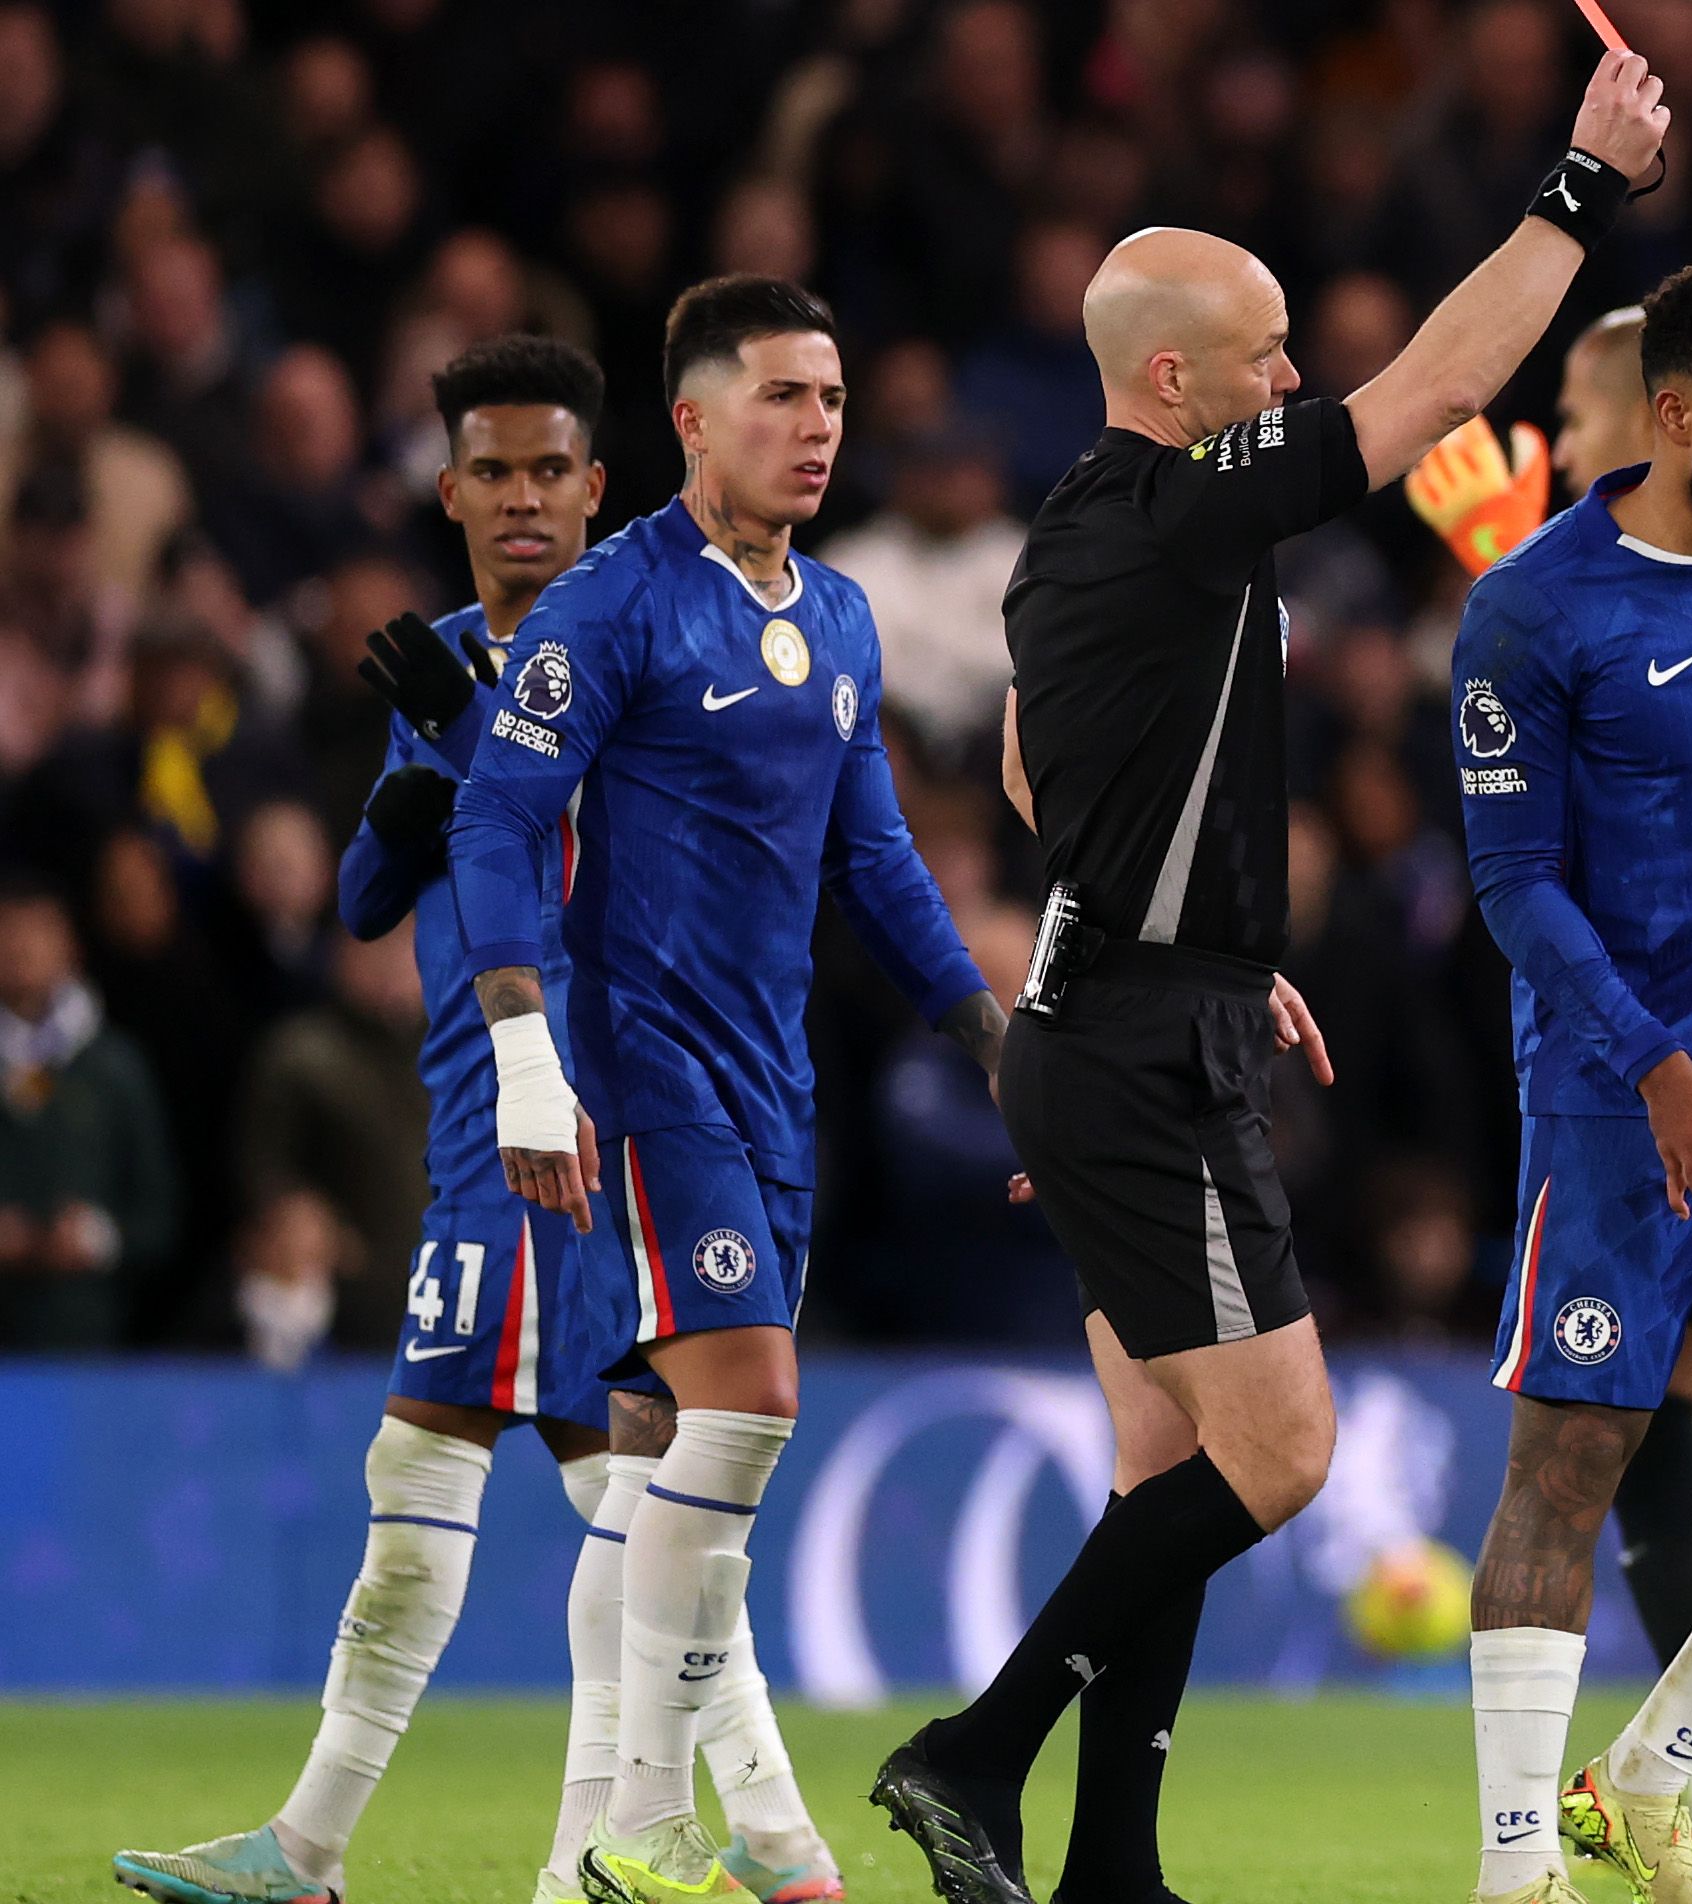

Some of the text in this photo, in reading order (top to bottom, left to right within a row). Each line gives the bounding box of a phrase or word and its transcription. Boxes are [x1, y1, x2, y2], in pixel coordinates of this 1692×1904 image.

[1257, 426, 1272, 449] No
[496, 709, 558, 745] No room
[510, 730, 560, 759] racism
[1460, 767, 1518, 783] No room
[1478, 780, 1527, 794] racism
[702, 1231, 742, 1248] CHELSEA
[407, 1240, 486, 1336] 41
[1569, 1300, 1612, 1318] CHELSEA
[683, 1651, 729, 1666] CFC
[1495, 1810, 1540, 1827] CFC
